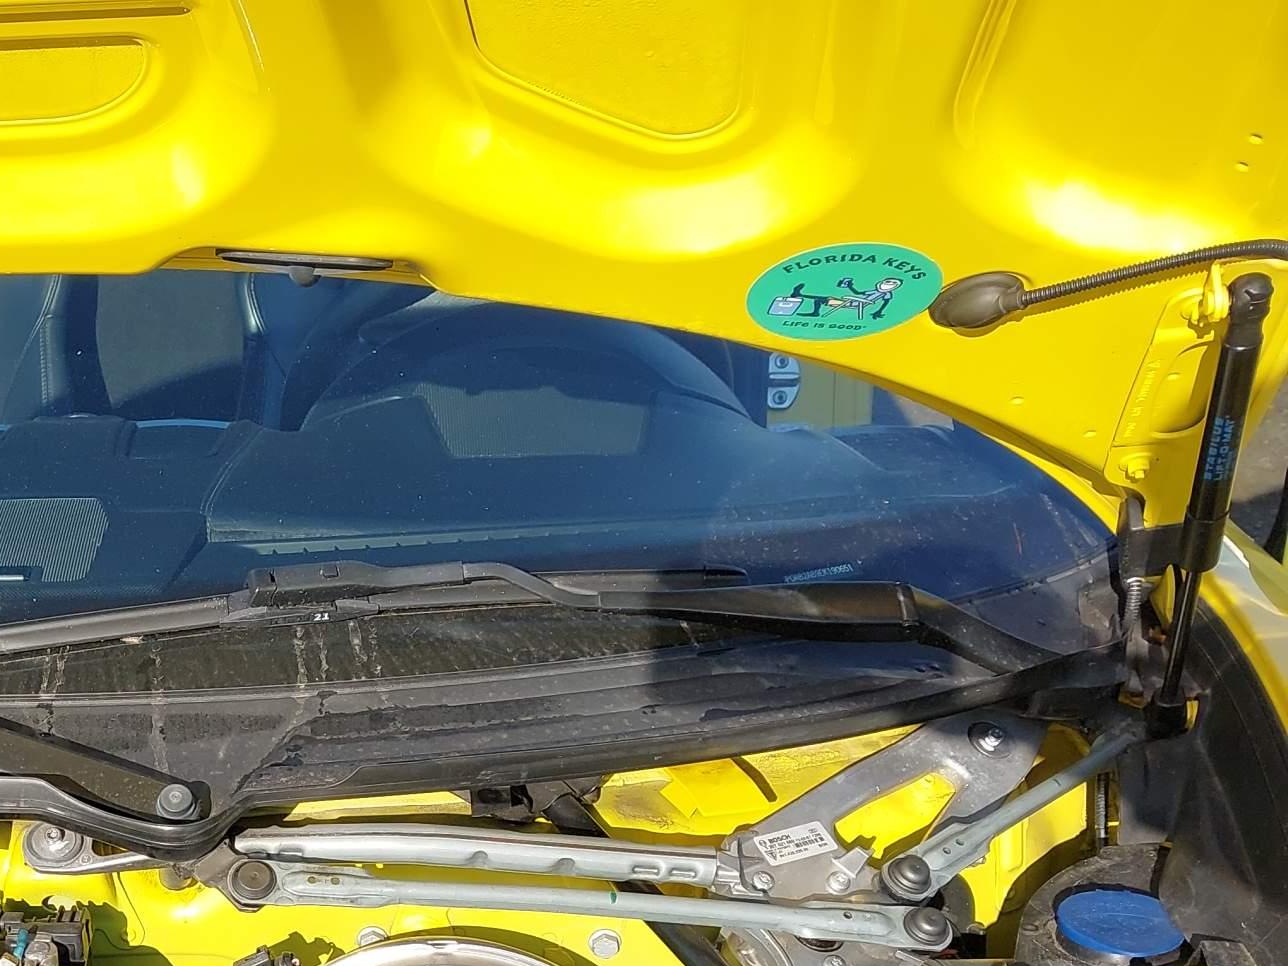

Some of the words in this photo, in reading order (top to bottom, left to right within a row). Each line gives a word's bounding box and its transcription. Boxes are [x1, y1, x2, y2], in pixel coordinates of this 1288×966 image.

[782, 253, 877, 274] FLORIDA
[881, 257, 927, 280] KEYS
[1204, 416, 1225, 480] STABILUS
[313, 612, 330, 621] 21
[768, 834, 791, 844] BOSCH
